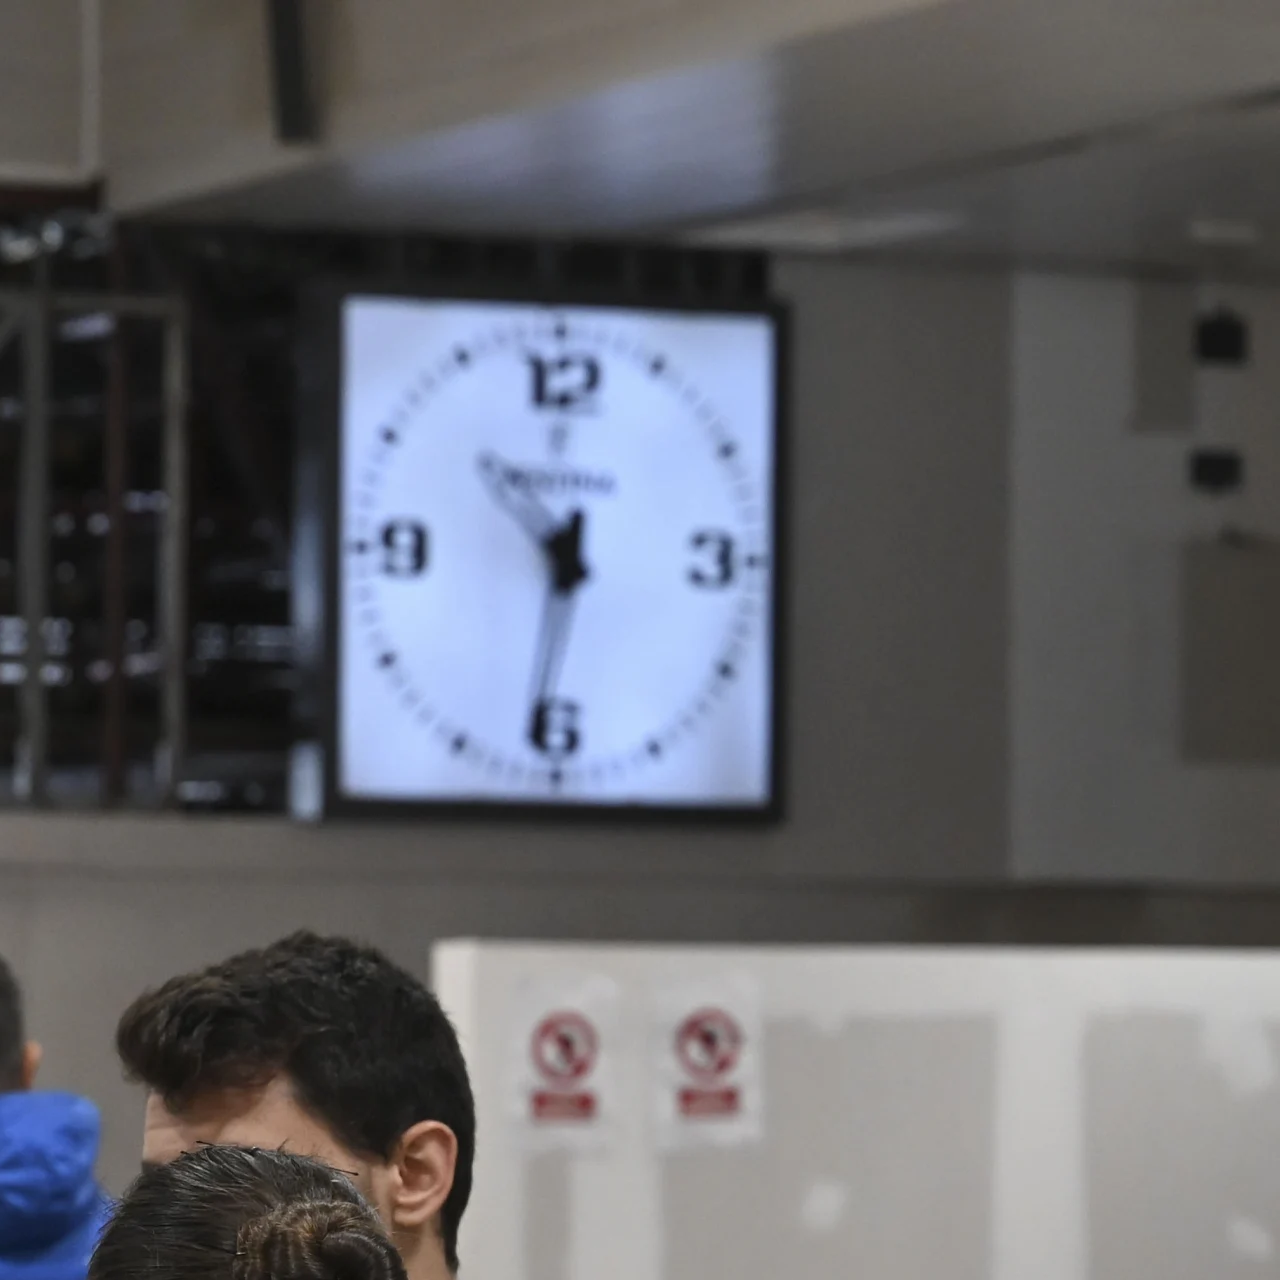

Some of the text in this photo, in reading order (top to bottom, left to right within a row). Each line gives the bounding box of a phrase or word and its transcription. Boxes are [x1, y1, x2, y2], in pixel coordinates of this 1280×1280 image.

[528, 350, 600, 413] 12
[380, 519, 428, 578] 9
[688, 530, 735, 588] 3
[529, 696, 581, 755] 6
